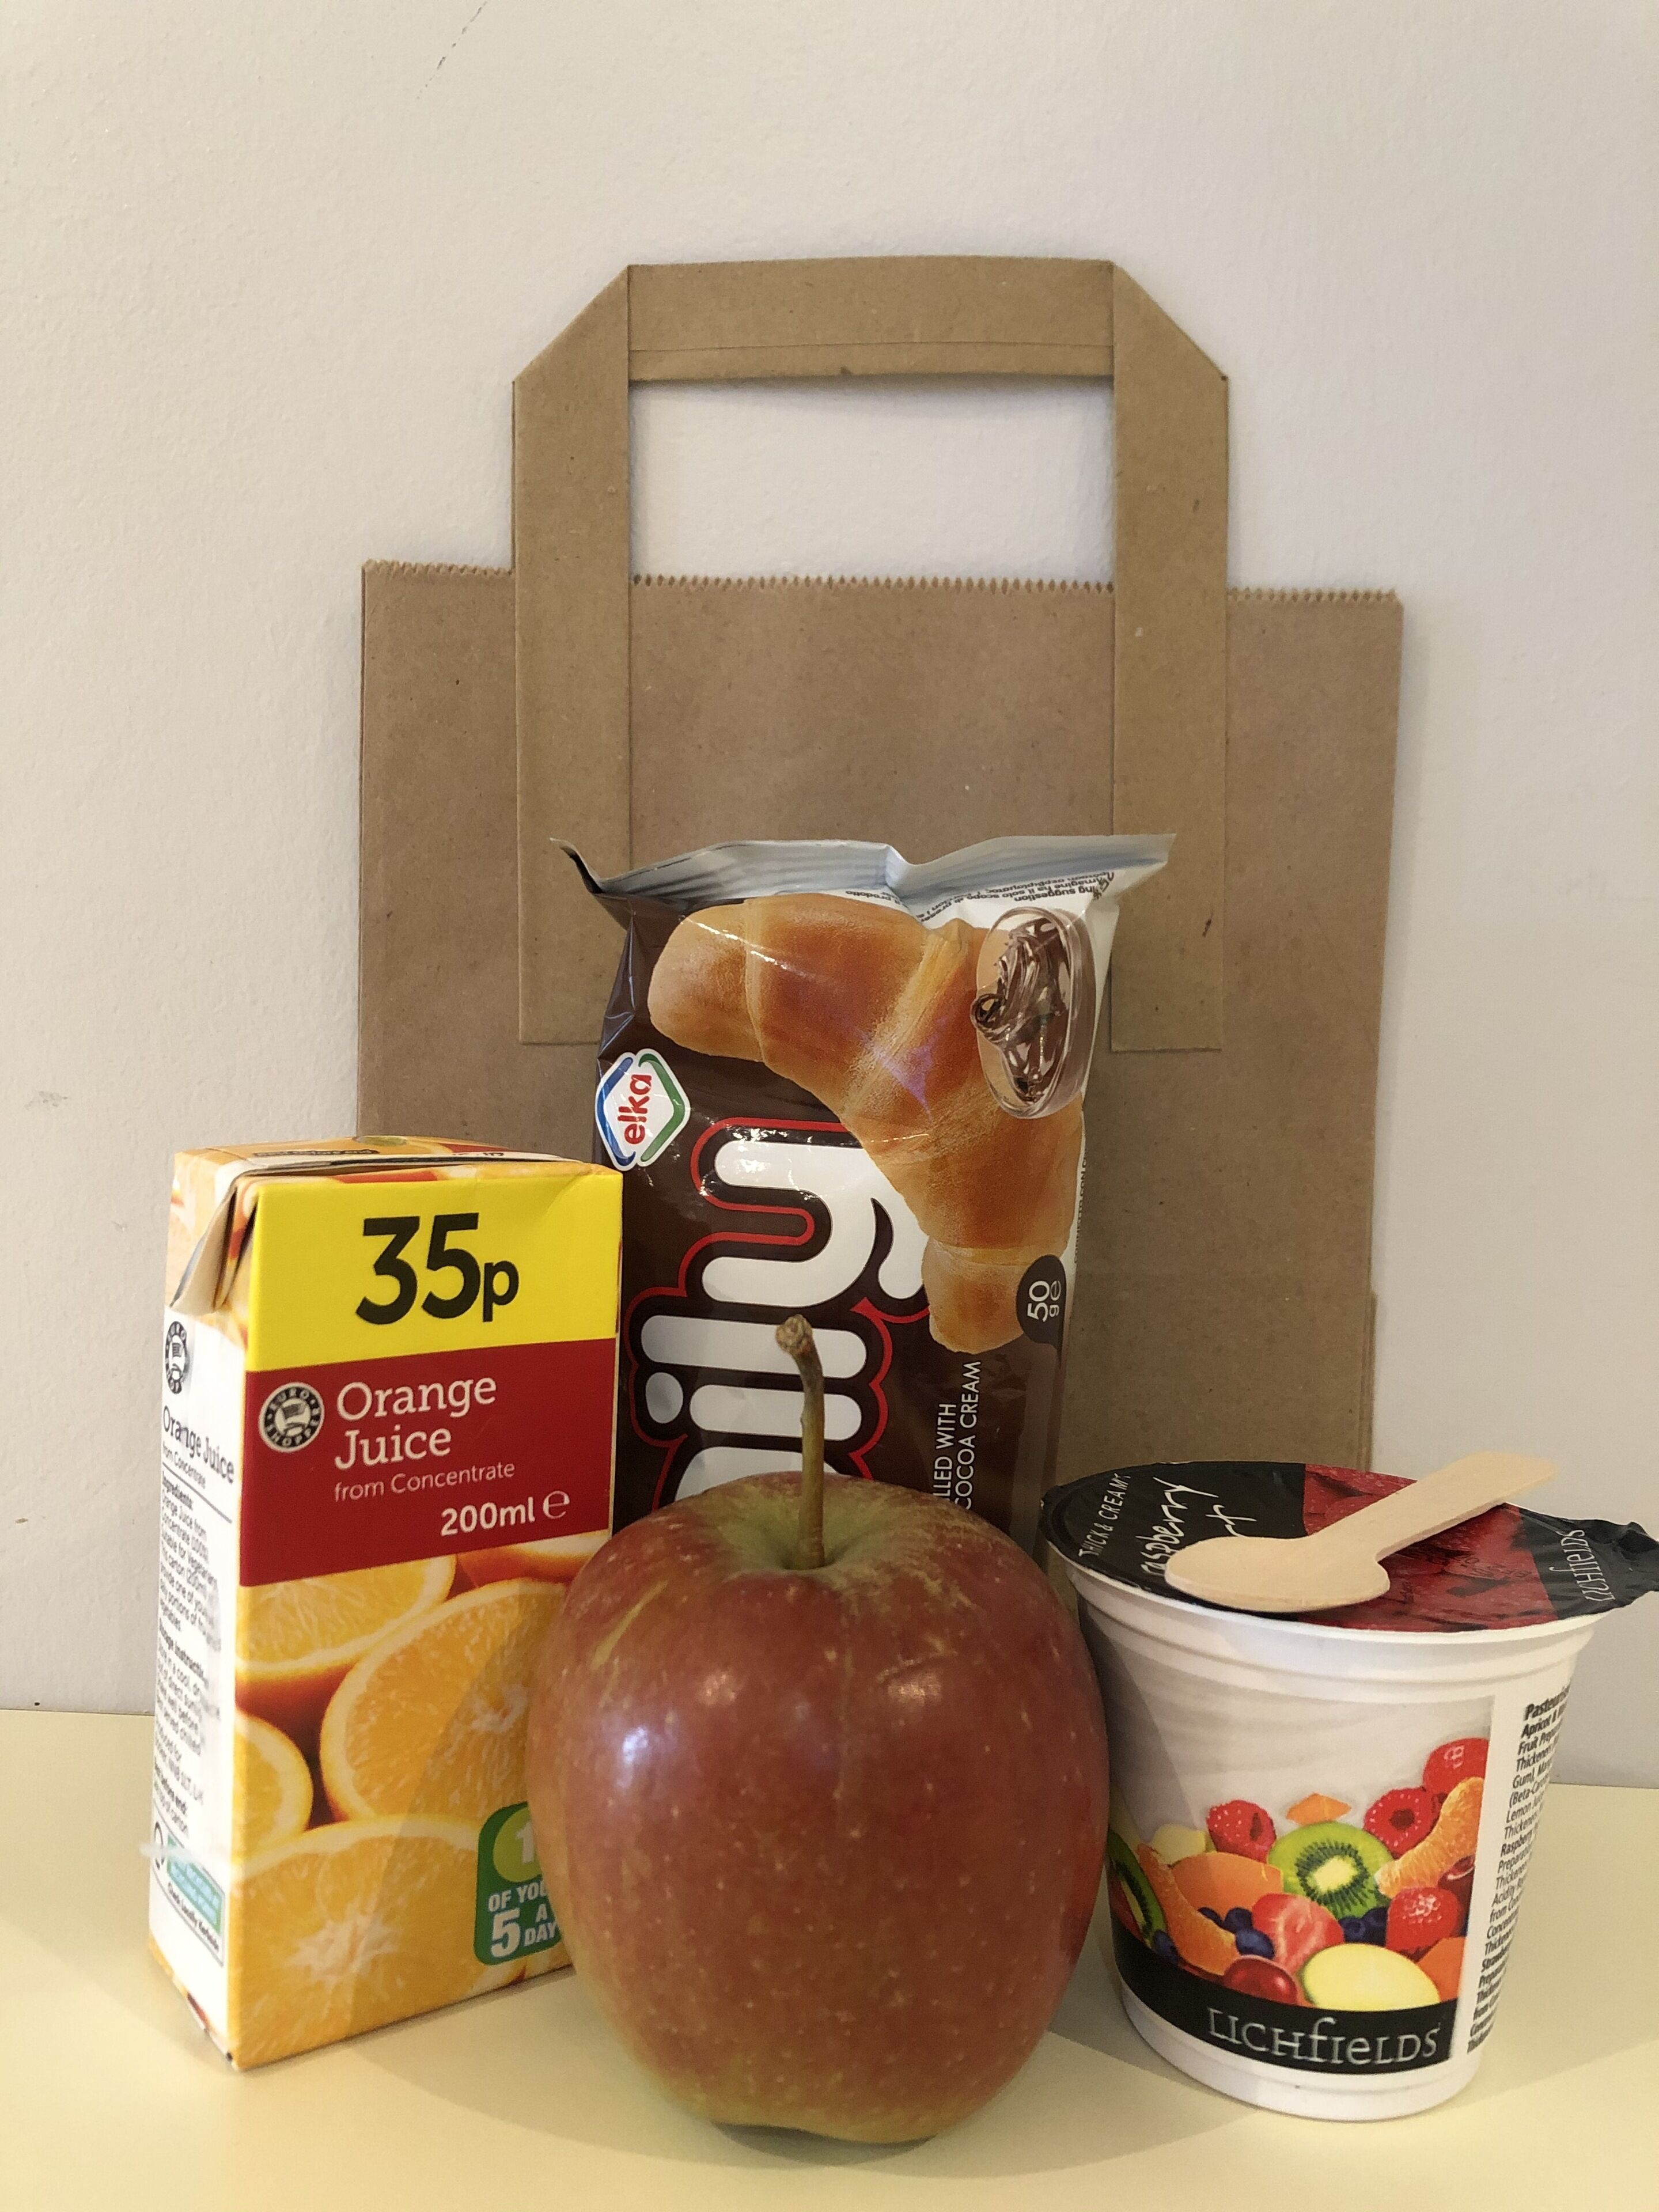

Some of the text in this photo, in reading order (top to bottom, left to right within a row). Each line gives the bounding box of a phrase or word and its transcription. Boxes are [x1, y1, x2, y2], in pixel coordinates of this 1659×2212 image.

[845, 891, 892, 902] prodotto
[1014, 885, 1082, 902] suggestion
[618, 1074, 652, 1145] elka
[356, 1213, 520, 1325] 35p
[1027, 1281, 1050, 1322] 50
[270, 1387, 310, 1411] EURO
[337, 1377, 497, 1423] Orange
[960, 1361, 981, 1428] CREAM
[163, 1405, 234, 1484] Orange Juice
[935, 1404, 957, 1449] WITH
[335, 1427, 452, 1471] Juice
[334, 1461, 516, 1502] from Concentrate
[440, 1498, 536, 1536] 200ml
[1079, 1473, 1131, 1556] THICK & CREAMY
[516, 1821, 535, 1864] 1
[488, 1880, 547, 1912] OF YOU
[490, 1903, 548, 1957] 5 A
[524, 1921, 558, 1947] DAY
